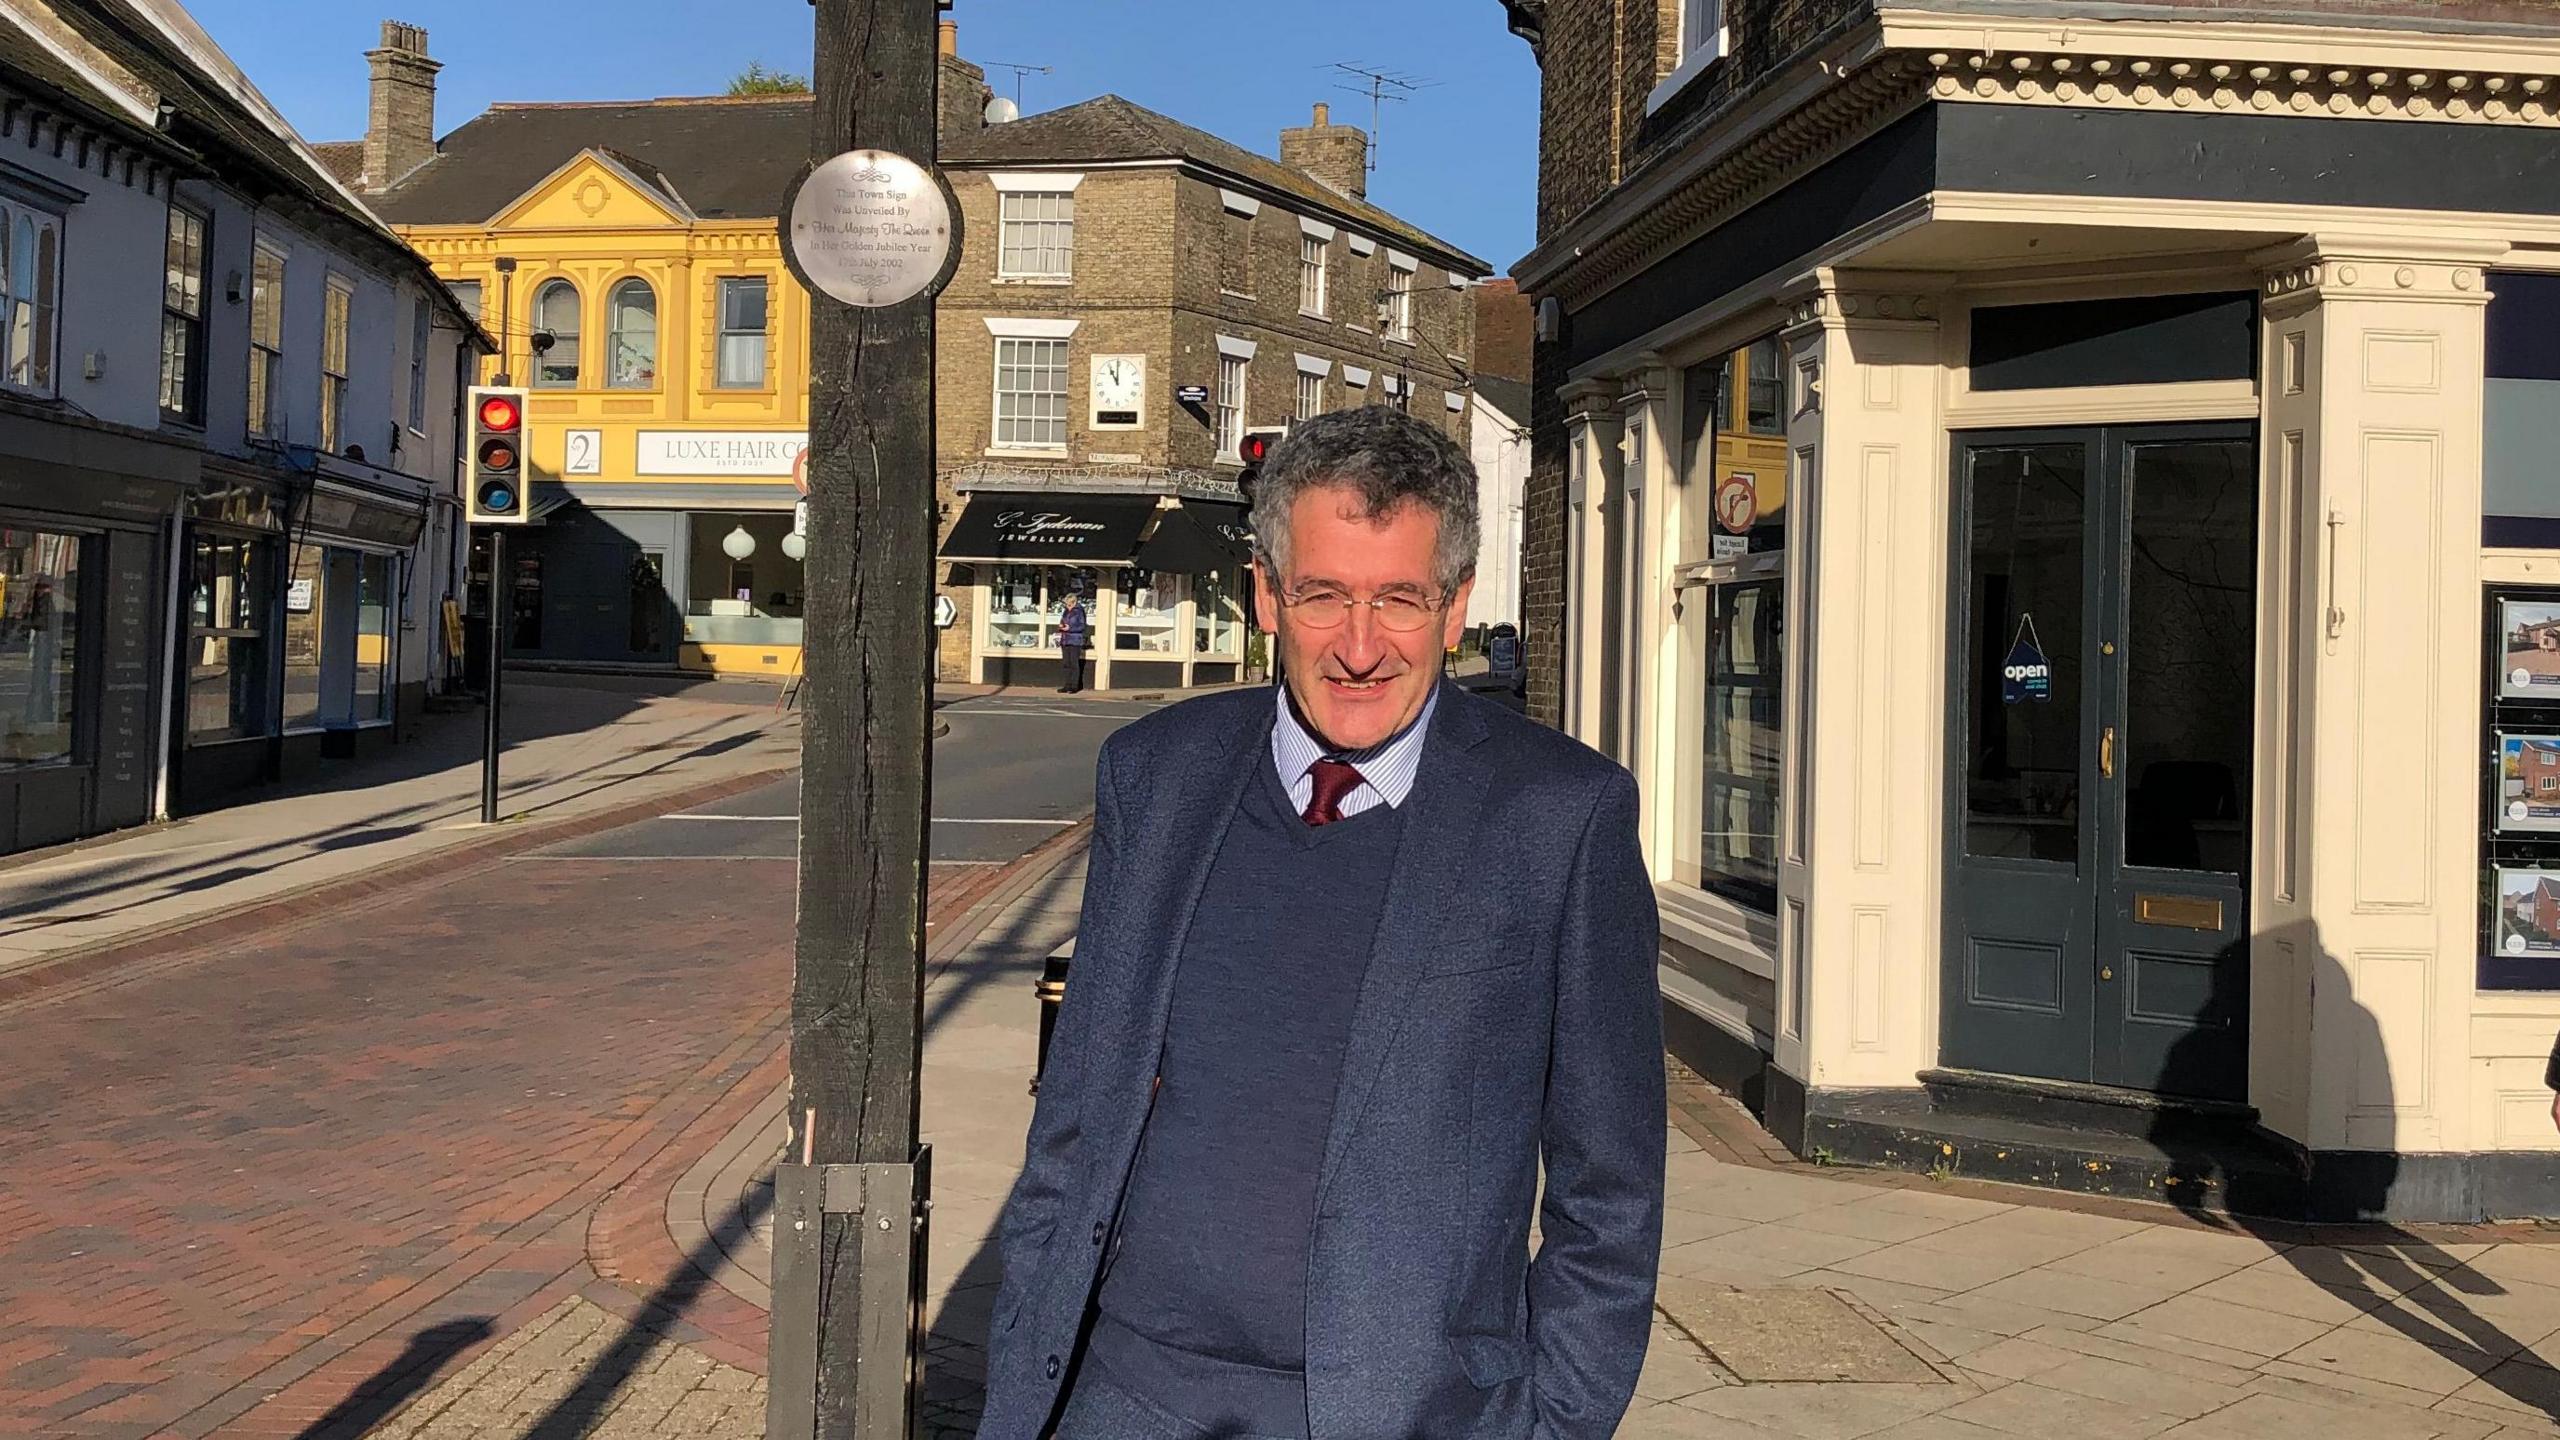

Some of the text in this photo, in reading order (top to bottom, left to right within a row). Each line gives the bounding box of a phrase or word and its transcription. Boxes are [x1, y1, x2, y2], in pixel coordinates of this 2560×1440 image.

[836, 188, 907, 201] This Town Sign
[833, 205, 911, 217] Was Unveiled By
[838, 222, 879, 237] Majesty
[881, 222, 901, 235] The
[903, 223, 930, 236] Queen
[810, 241, 932, 253] In Her Golden Jubilee Year
[860, 258, 879, 269] July
[880, 259, 903, 268] 2002
[571, 434, 591, 470] 2
[666, 441, 721, 459] LUXE
[727, 441, 778, 459] HAIR
[1018, 512, 1106, 534] Tydeman
[998, 534, 1085, 543] JEWELLERS
[2004, 664, 2048, 682] open
